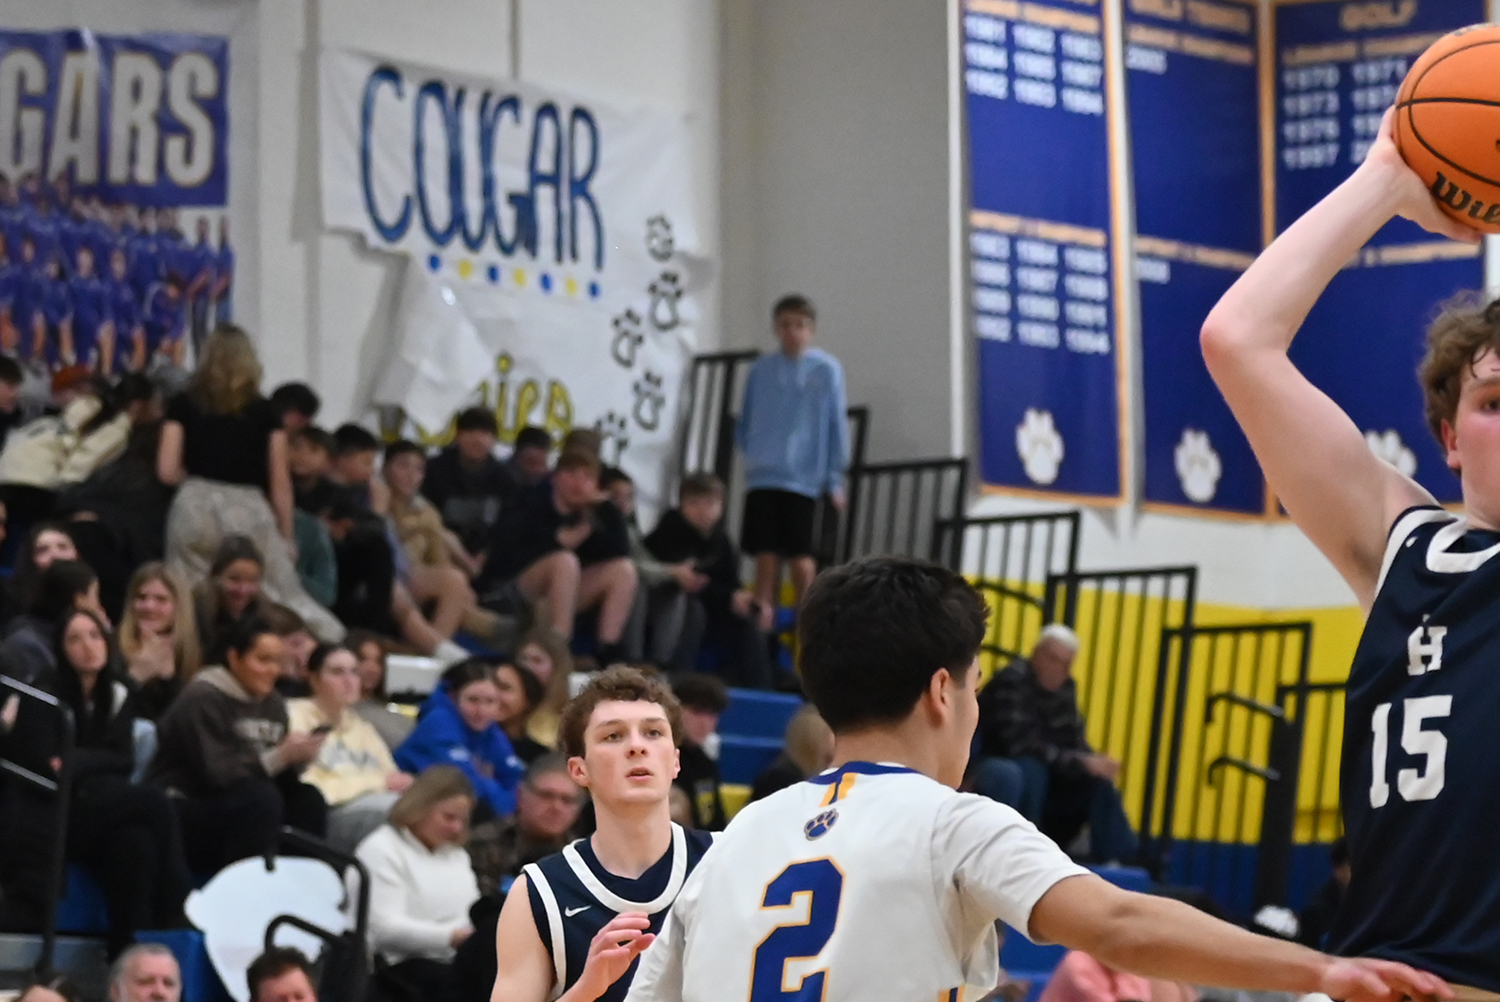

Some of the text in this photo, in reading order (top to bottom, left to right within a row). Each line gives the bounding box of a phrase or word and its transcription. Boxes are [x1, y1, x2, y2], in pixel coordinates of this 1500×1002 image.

[359, 63, 605, 270] COUGAR
[1407, 613, 1448, 676] H
[1369, 694, 1453, 809] 15
